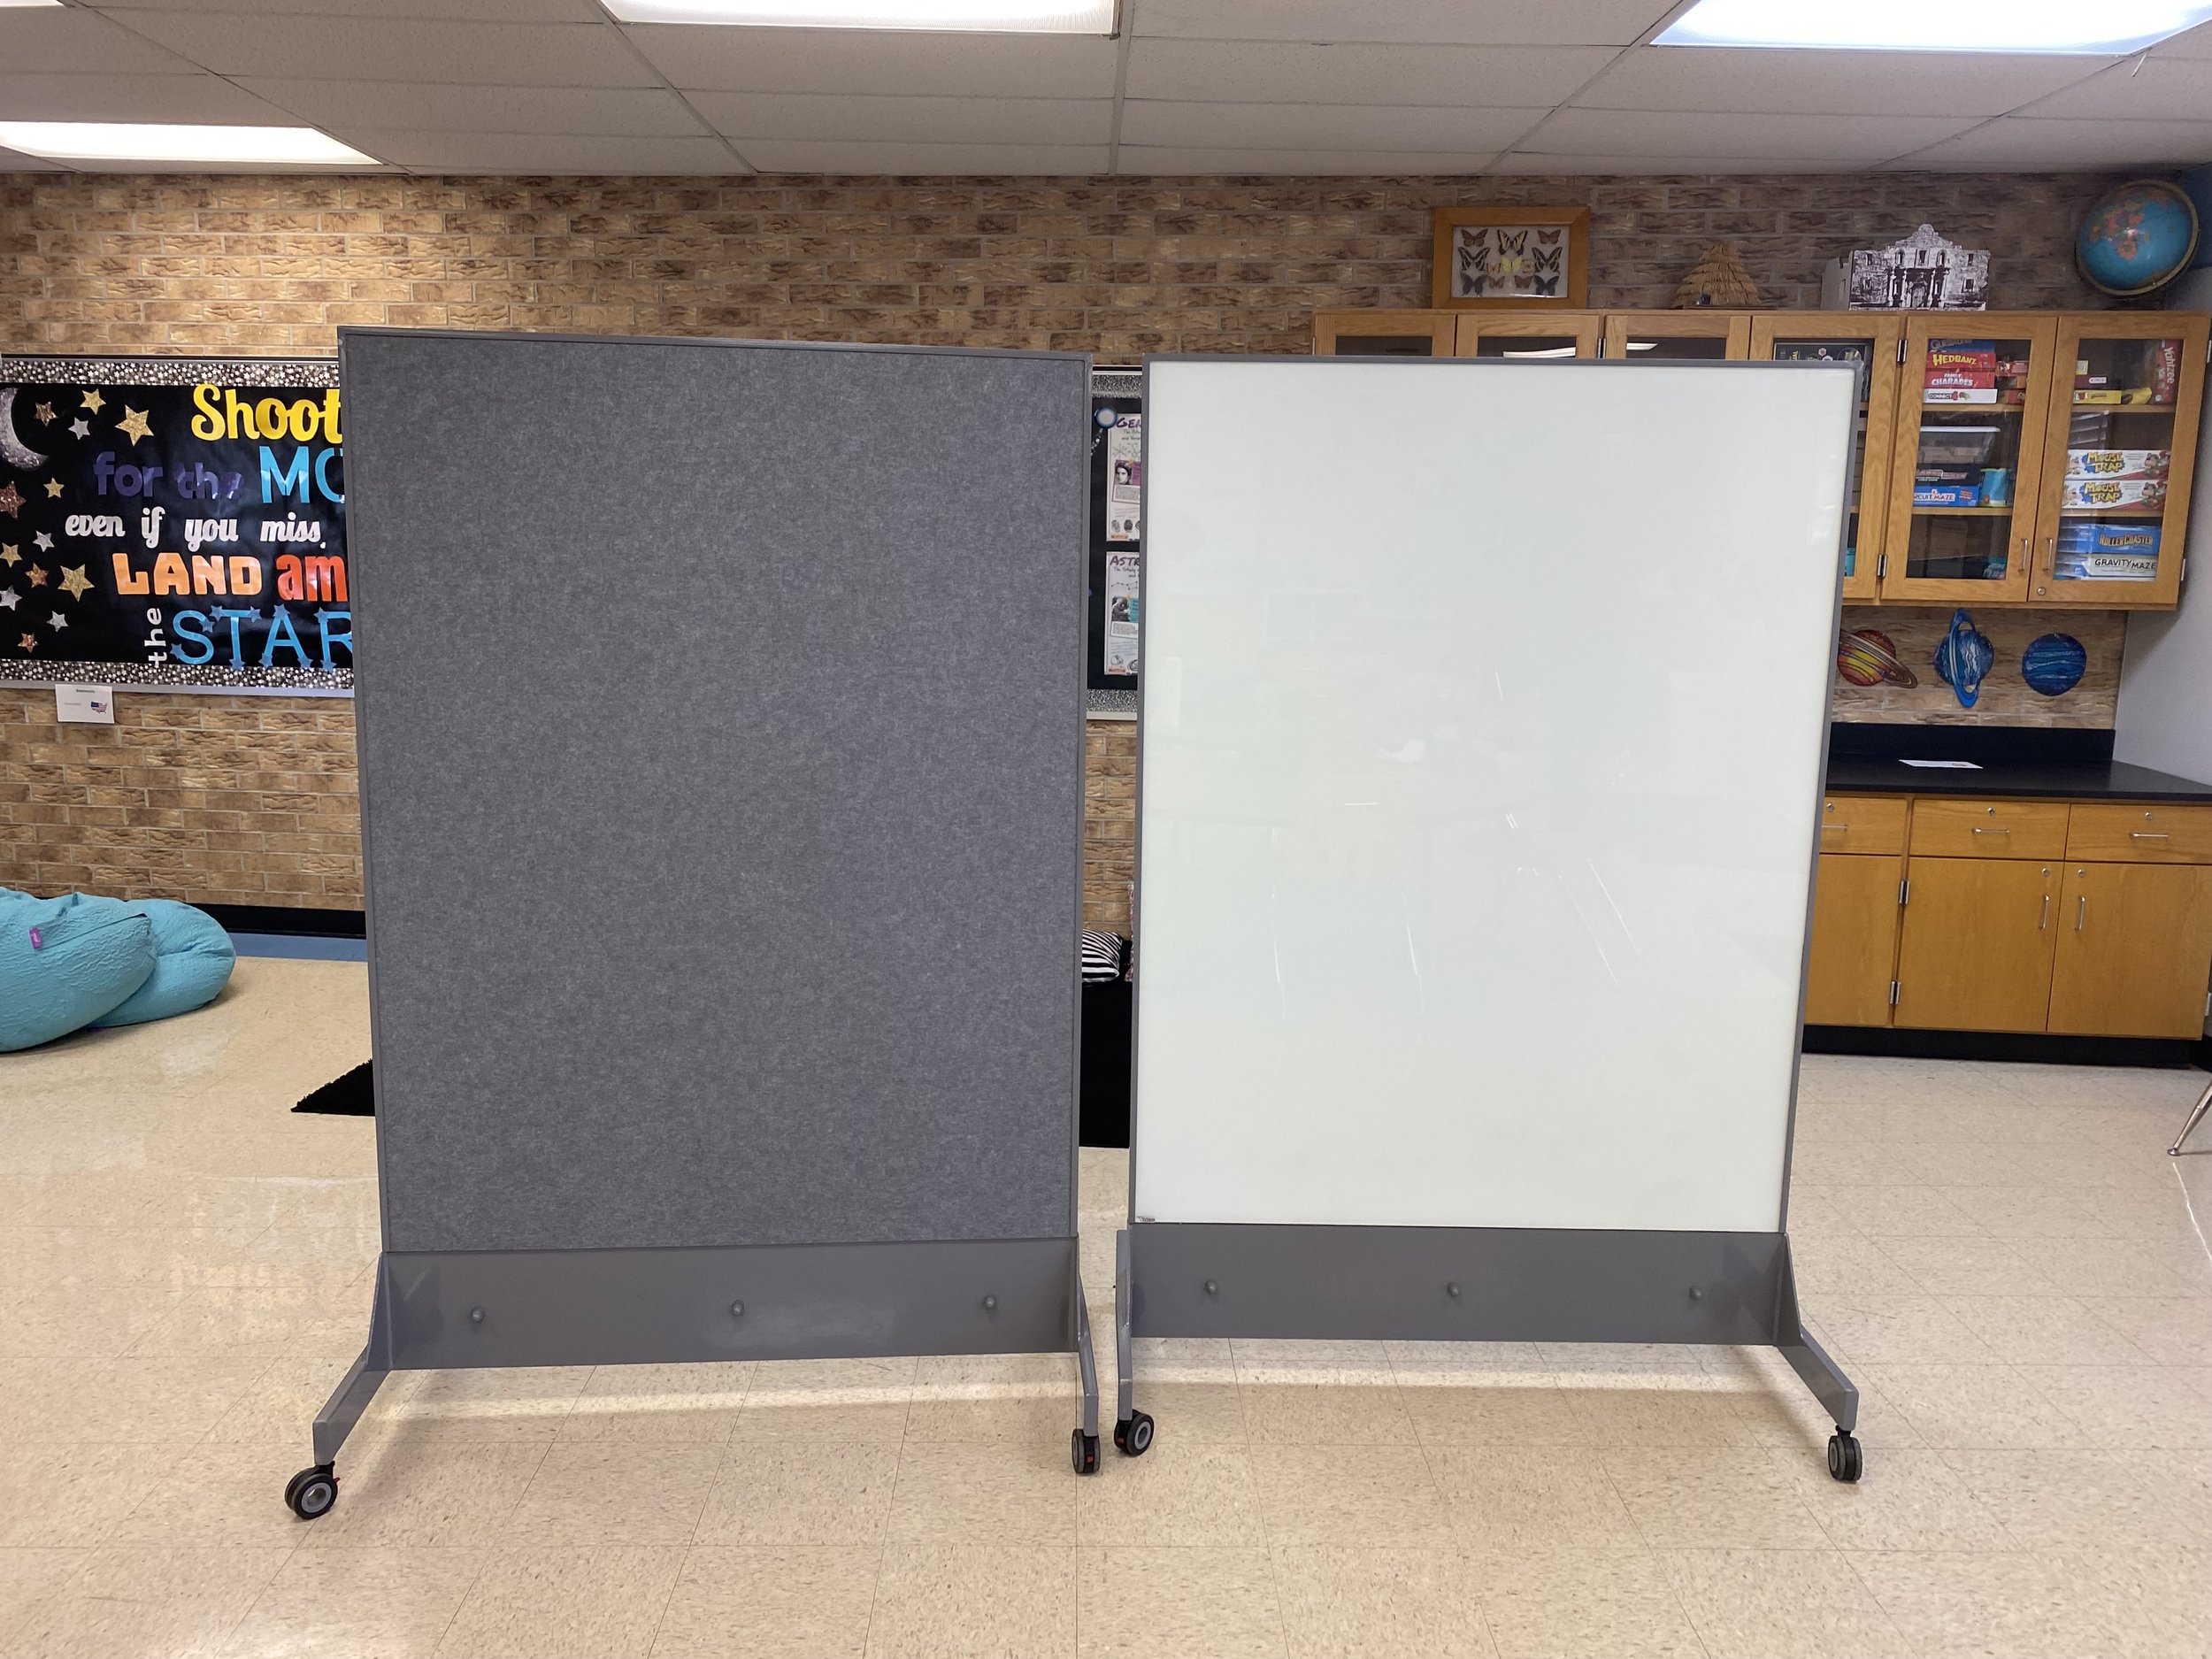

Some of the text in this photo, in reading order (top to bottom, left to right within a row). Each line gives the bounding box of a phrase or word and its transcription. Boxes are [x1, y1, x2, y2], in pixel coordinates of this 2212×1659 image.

[1932, 378, 1974, 387] CHARADES
[191, 383, 343, 444] Shoot
[2087, 452, 2123, 463] MOUSE
[2094, 461, 2124, 472] TRAP
[94, 451, 163, 497] for
[175, 462, 243, 499] the
[2085, 482, 2120, 494] MOUSE
[2091, 492, 2120, 503] TRAP
[65, 514, 126, 537] even
[141, 506, 165, 549] if
[184, 518, 239, 552] you
[2099, 534, 2124, 547] ROLLER
[2124, 534, 2154, 545] COASTER
[2094, 559, 2131, 568] GRAVITY
[111, 553, 348, 602] LAND am
[144, 607, 167, 668] the
[170, 604, 353, 672] STAR
